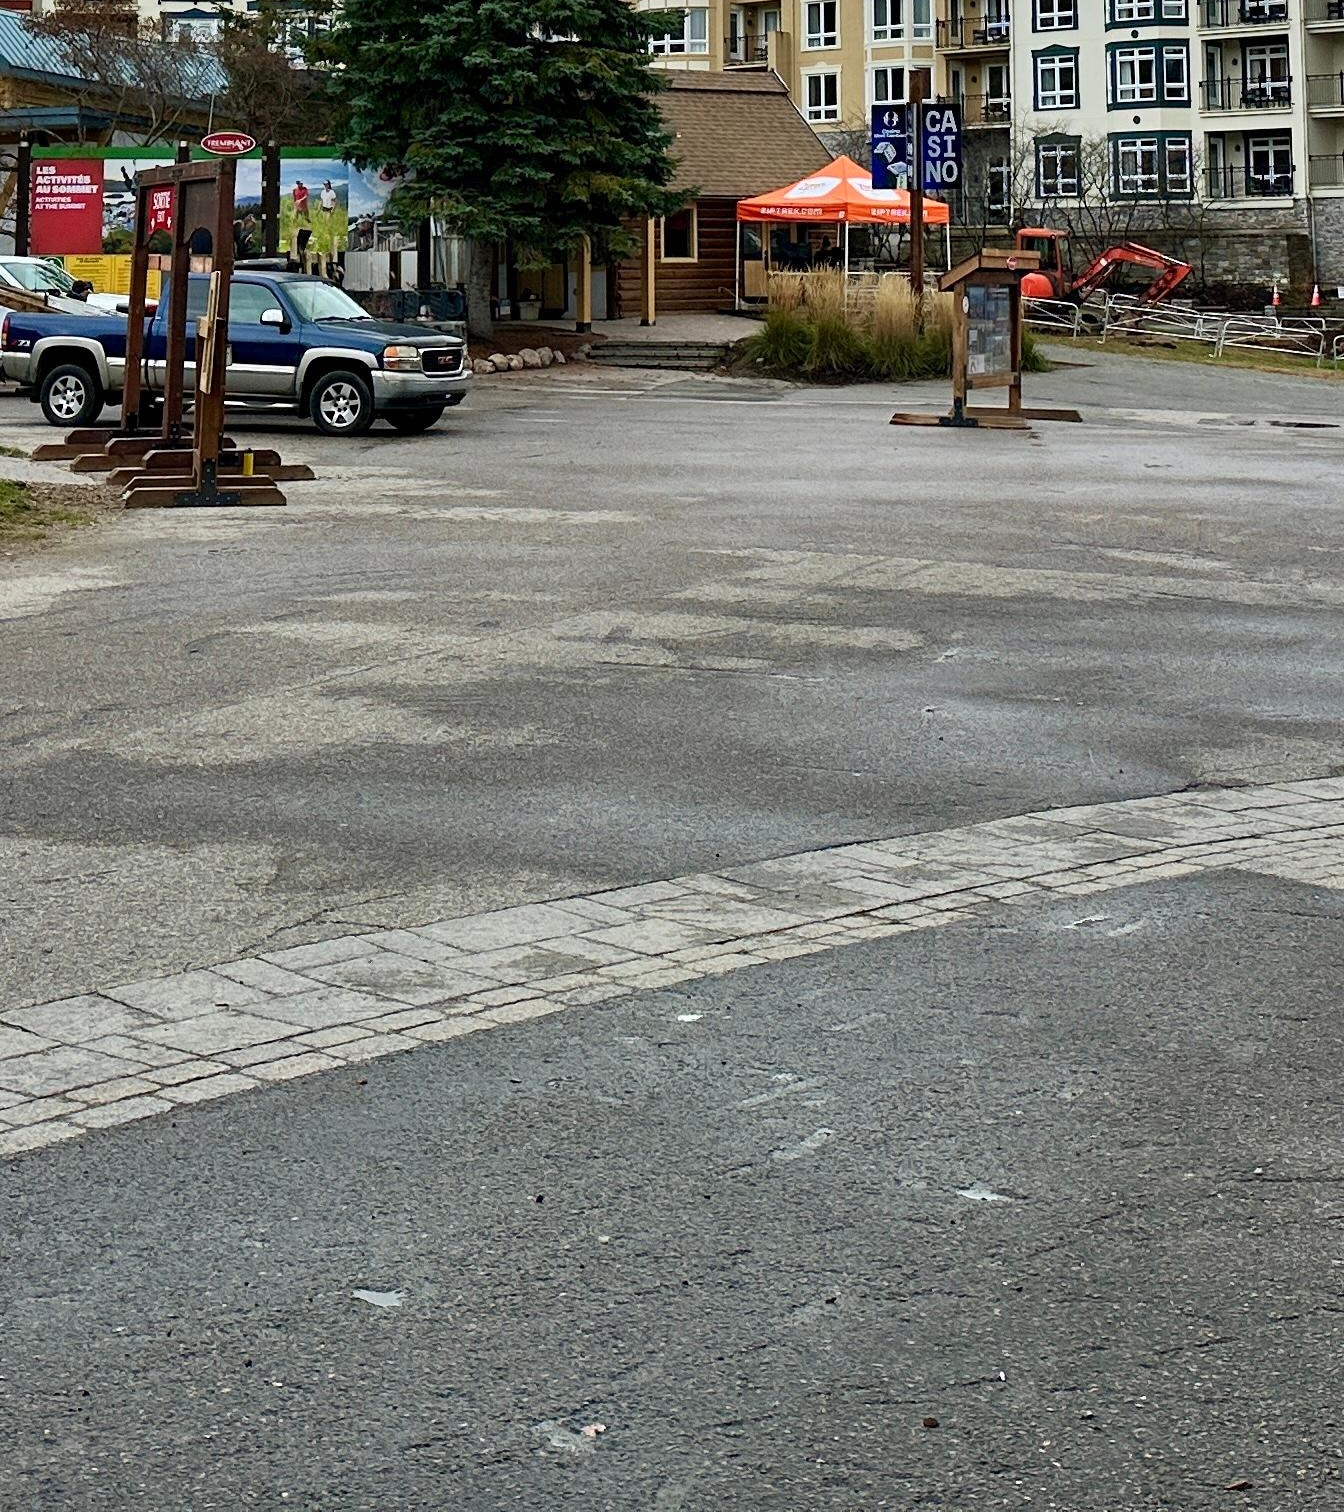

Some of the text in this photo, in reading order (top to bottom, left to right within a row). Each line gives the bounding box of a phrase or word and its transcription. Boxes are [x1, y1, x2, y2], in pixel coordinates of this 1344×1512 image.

[207, 139, 251, 151] TREMBLANT
[36, 166, 56, 175] LES
[35, 174, 91, 185] ACTIVITÉS
[35, 185, 51, 194] AU
